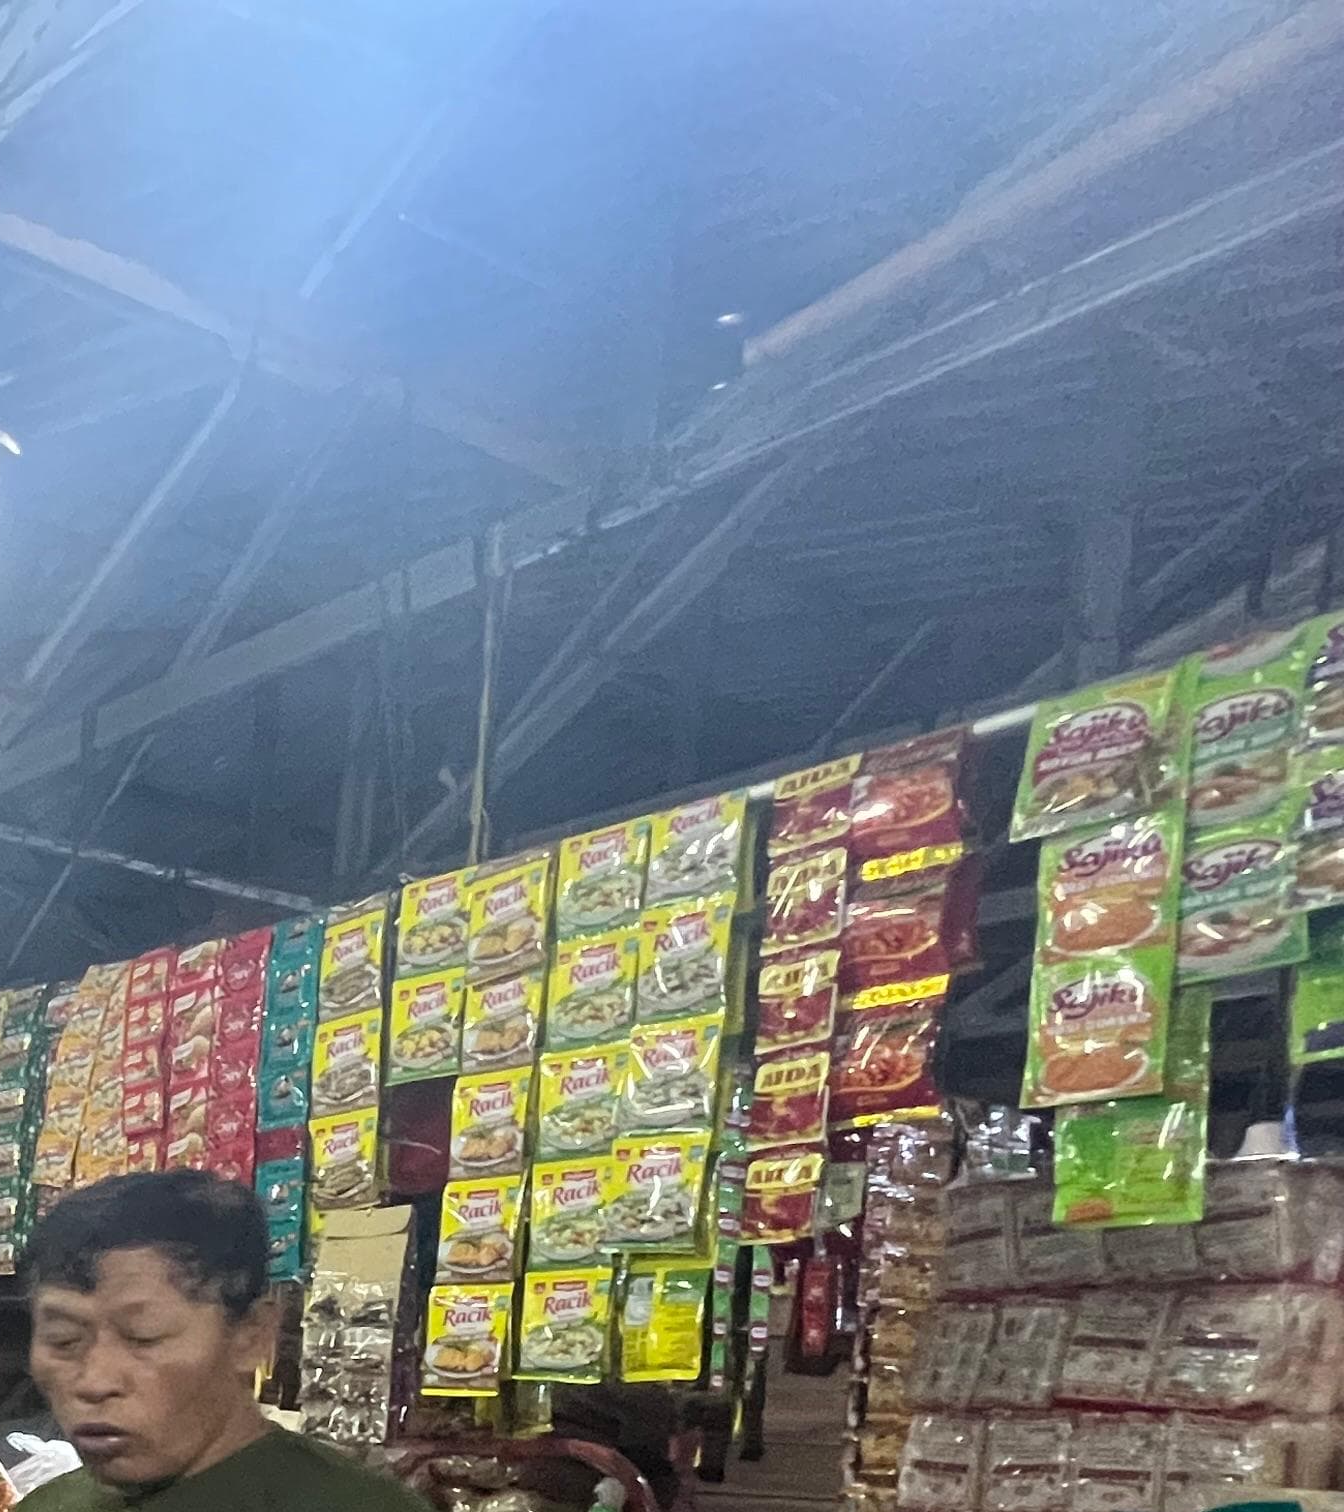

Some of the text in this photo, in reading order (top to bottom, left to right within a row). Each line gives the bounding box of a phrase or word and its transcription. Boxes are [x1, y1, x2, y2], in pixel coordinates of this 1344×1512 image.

[569, 953, 621, 984] Racik
[559, 1066, 611, 1095] Racik
[760, 1063, 822, 1089] AIDA
[469, 1090, 514, 1118] Racik
[627, 1157, 682, 1183] Racik
[552, 1179, 602, 1206] Racik
[459, 1198, 502, 1220] Racik
[443, 1305, 493, 1327] Racik
[543, 1292, 593, 1316] Racik
